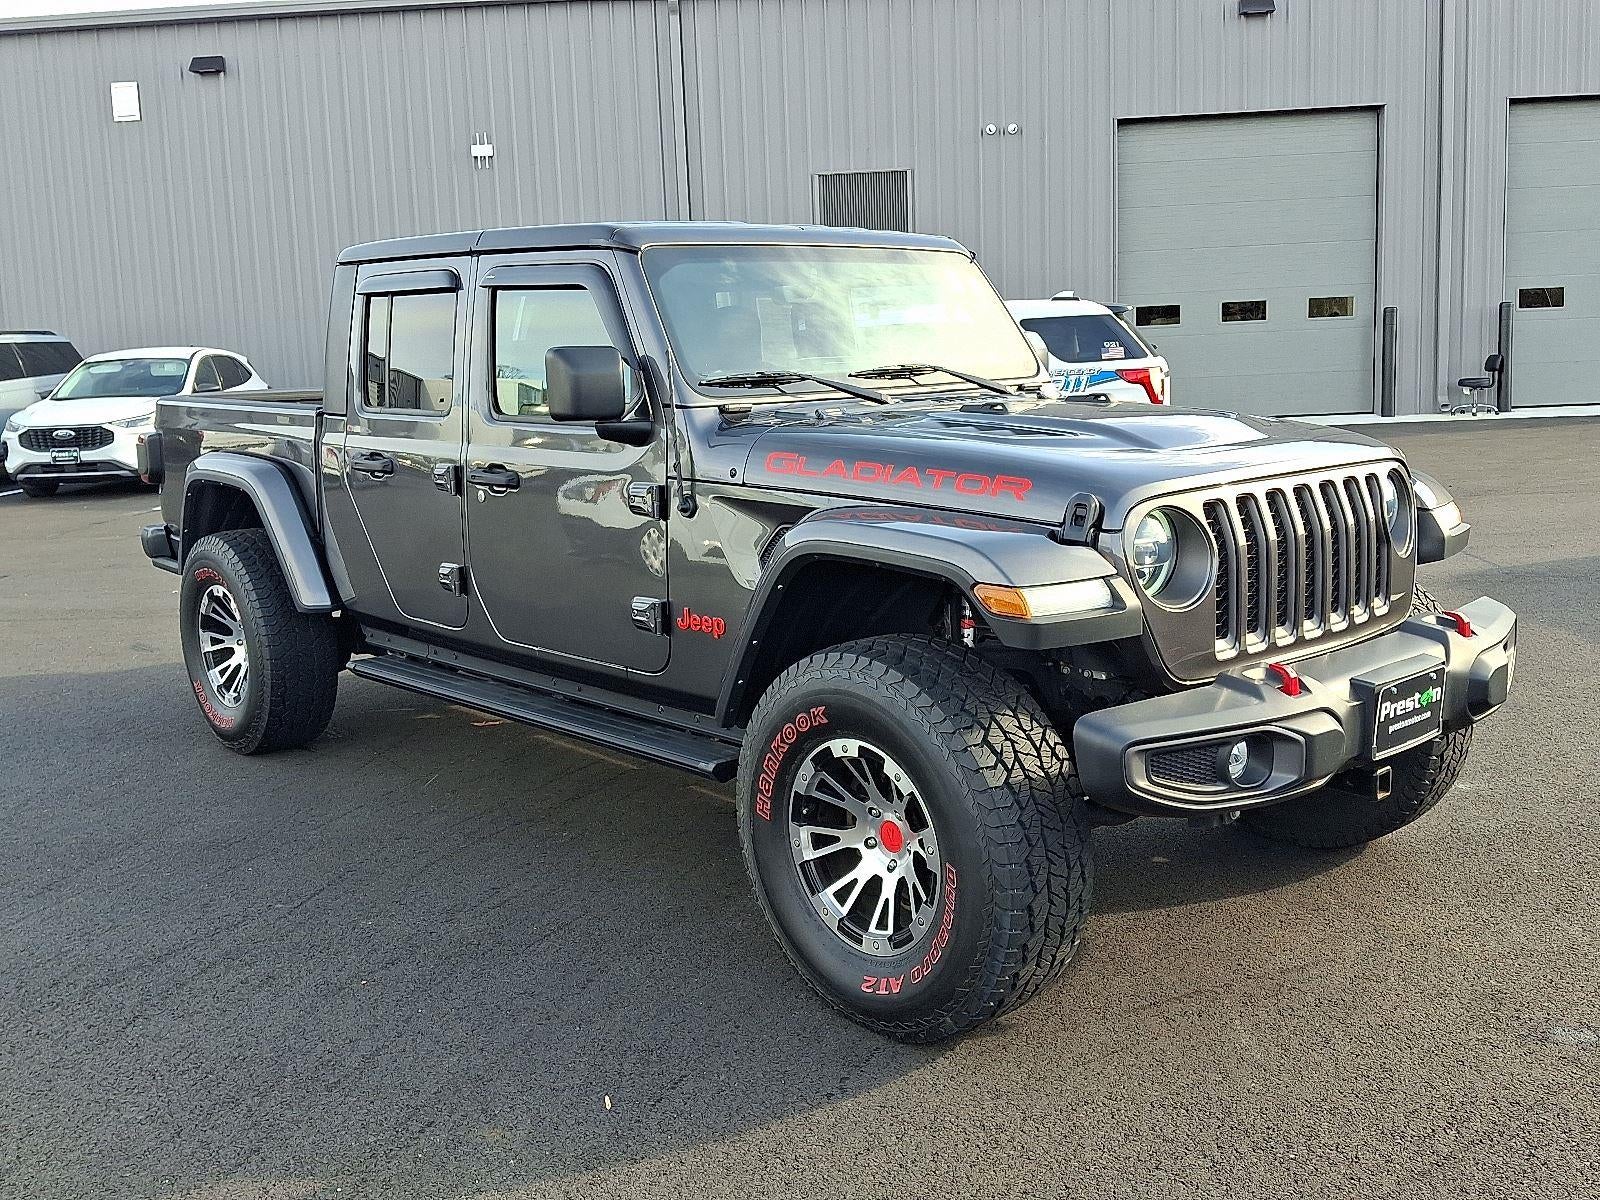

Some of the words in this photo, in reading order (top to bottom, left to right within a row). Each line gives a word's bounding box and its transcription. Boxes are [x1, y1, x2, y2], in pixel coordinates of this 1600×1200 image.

[765, 451, 1033, 502] GLADIATOR
[677, 607, 726, 639] Jeep
[1380, 686, 1442, 722] Preston
[860, 974, 905, 995] AT2
